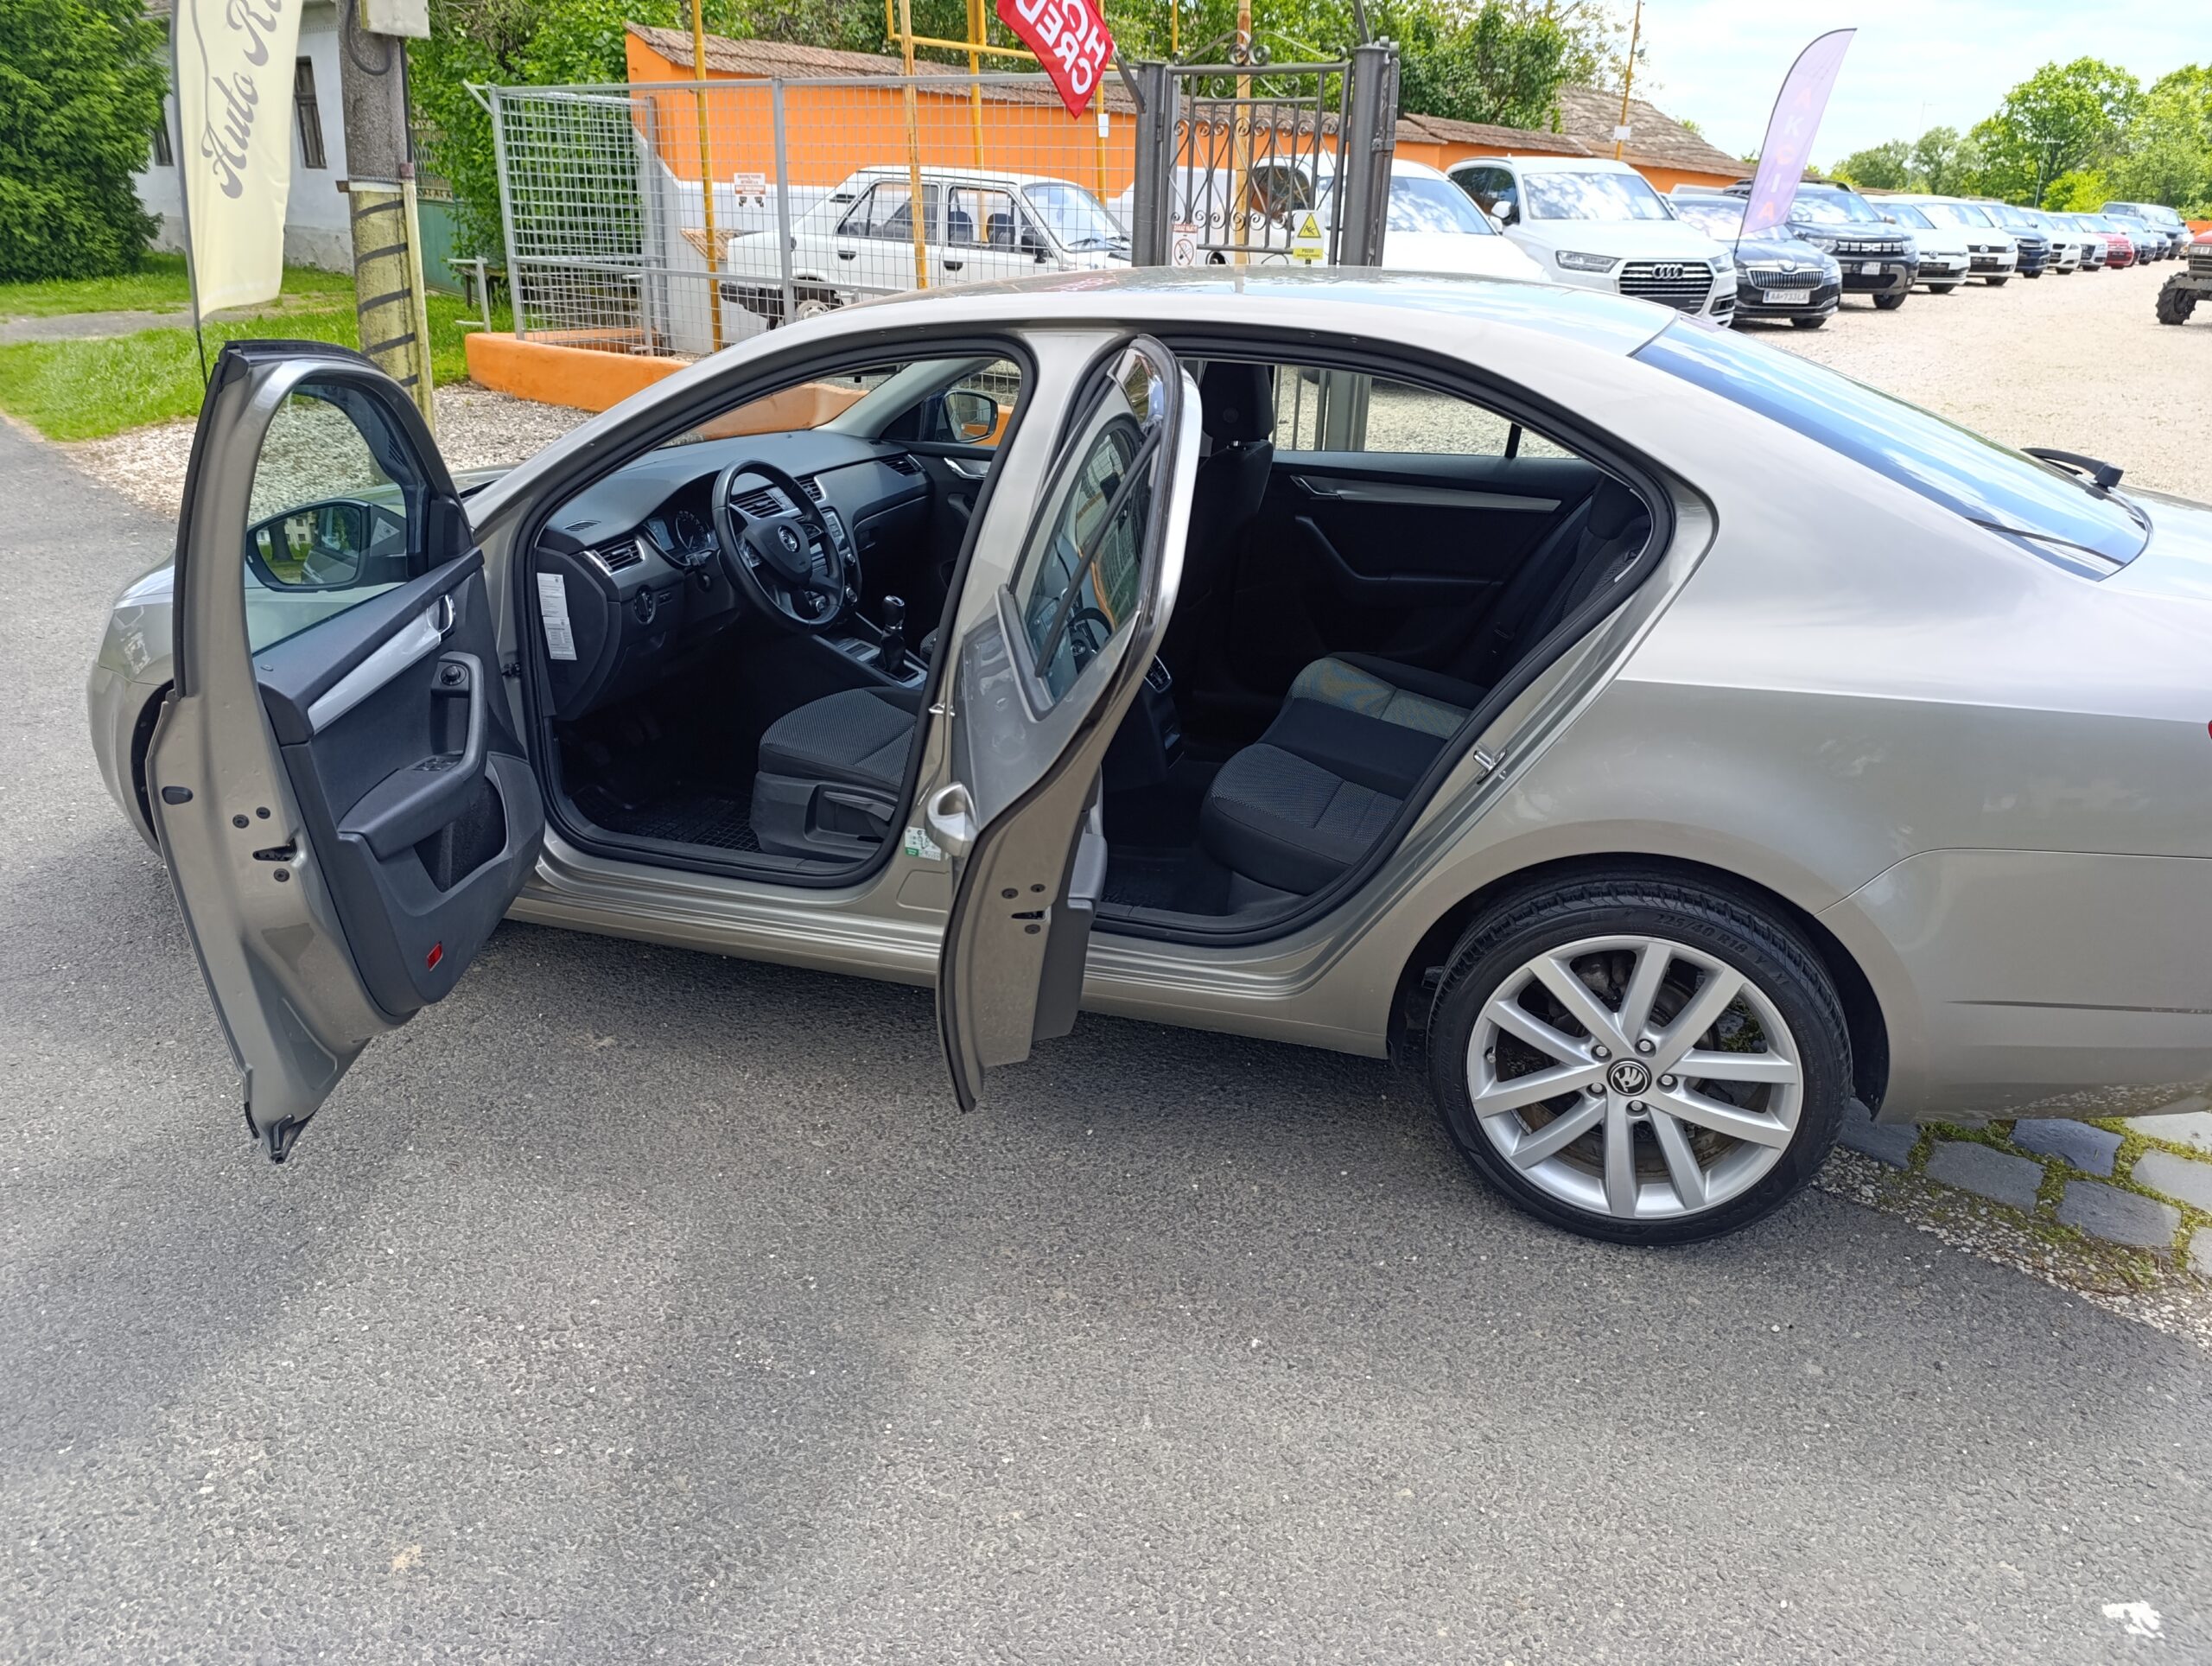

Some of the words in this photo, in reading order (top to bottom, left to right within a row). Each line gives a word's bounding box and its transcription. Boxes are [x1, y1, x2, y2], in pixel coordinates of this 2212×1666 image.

[201, 72, 258, 199] Auto
[1653, 913, 1715, 938] 225/40
[1716, 934, 1748, 953] R18
